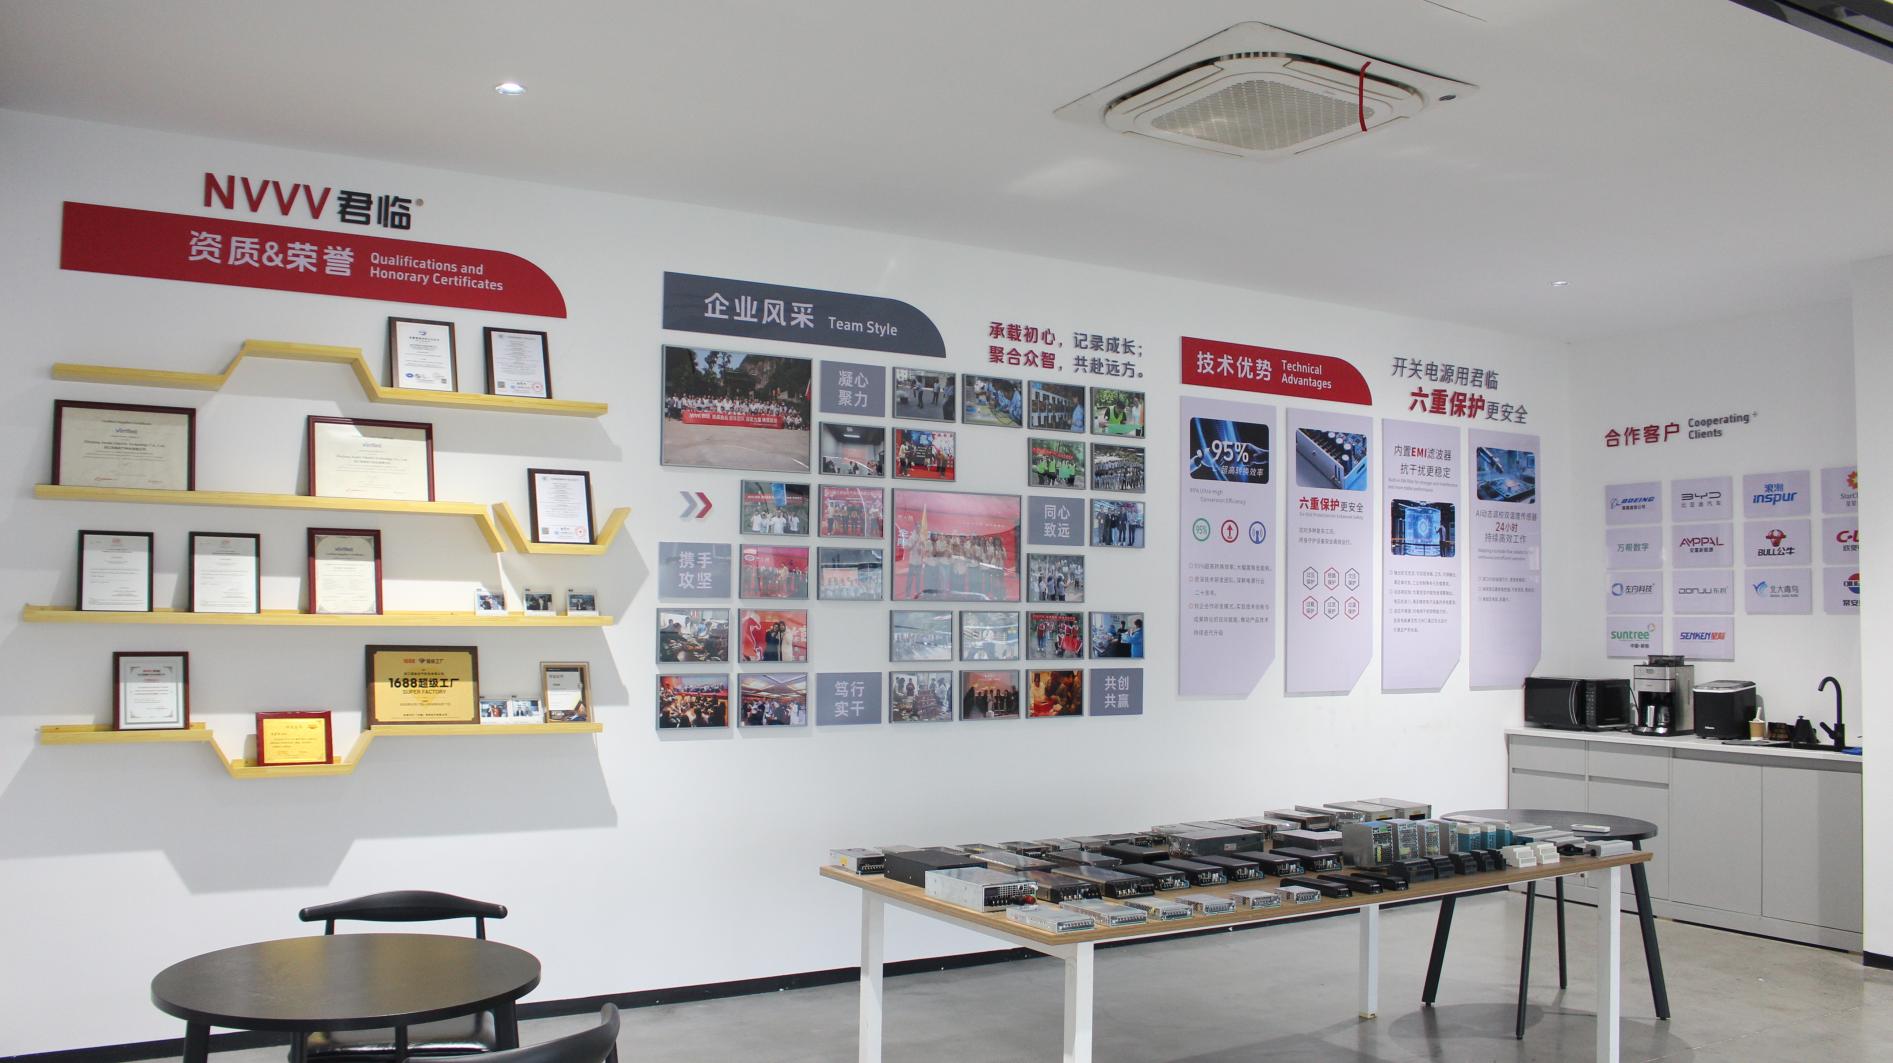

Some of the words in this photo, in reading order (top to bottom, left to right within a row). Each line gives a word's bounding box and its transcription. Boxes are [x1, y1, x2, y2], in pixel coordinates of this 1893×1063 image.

[204, 172, 331, 219] NVVV
[337, 190, 412, 230] 君临
[188, 230, 354, 276] 资质&荣誉
[370, 252, 457, 272] Qualifications
[460, 264, 484, 275] and
[370, 266, 429, 285] Honorary
[432, 273, 503, 291] Certificates
[704, 292, 814, 328] 企业风采
[828, 316, 863, 332] Team
[867, 320, 898, 337] Style
[1197, 351, 1272, 381] 技术优势
[1281, 360, 1322, 375] Technical
[1391, 356, 1499, 391] 开关电源用君临
[838, 369, 869, 388] 凝心
[1281, 373, 1332, 390] Advantages
[837, 389, 868, 408] 聚力
[1408, 386, 1528, 424] 六重保护更安全
[1688, 413, 1750, 428] Cooperating
[1604, 422, 1680, 447] 合作客户
[1688, 428, 1723, 440] Clients
[1211, 440, 1249, 463] 95%
[1681, 491, 1722, 501] BYD
[1752, 492, 1798, 505] inspur
[1044, 504, 1071, 520] 同心
[1043, 522, 1071, 538] 致远
[1495, 521, 1518, 533] 24小时
[679, 551, 713, 569] 携手
[678, 571, 713, 589] 攻坚
[1611, 630, 1649, 640] suntree
[388, 677, 460, 688] 1688超级工厂
[834, 680, 865, 698] 笃行
[1104, 675, 1129, 691] 共创
[834, 700, 865, 718] 实干
[1104, 693, 1129, 709] 共赢
